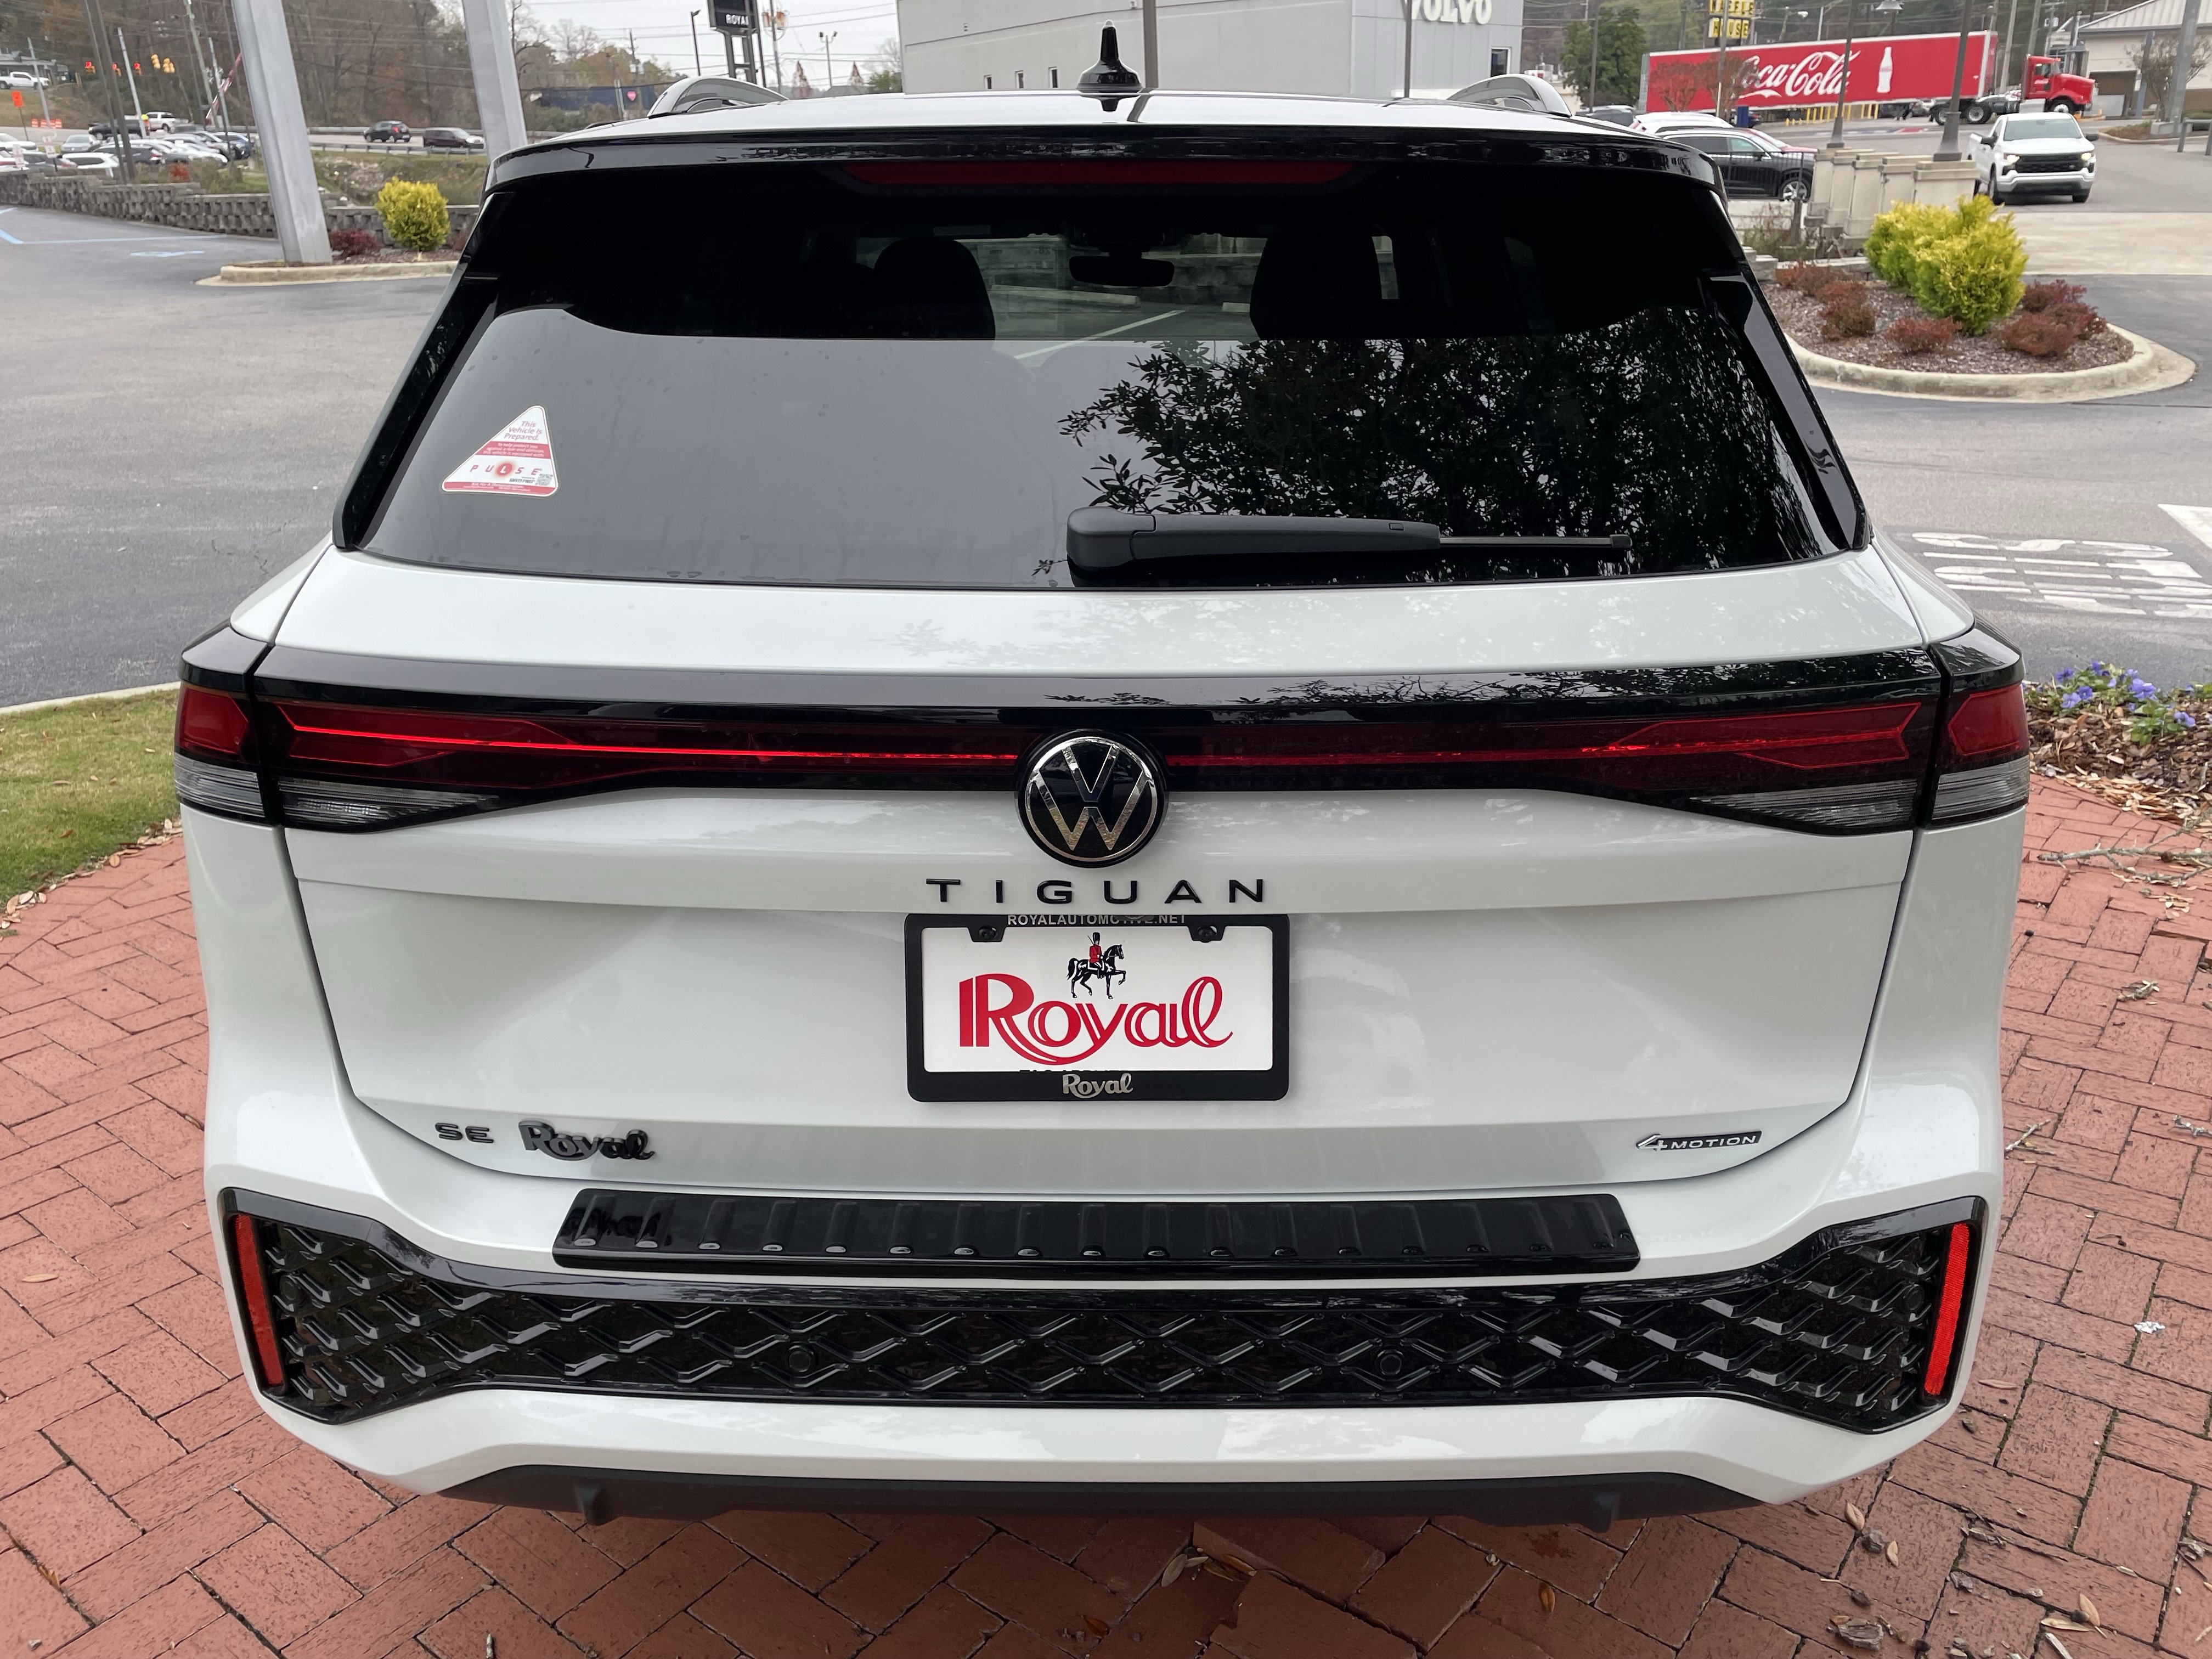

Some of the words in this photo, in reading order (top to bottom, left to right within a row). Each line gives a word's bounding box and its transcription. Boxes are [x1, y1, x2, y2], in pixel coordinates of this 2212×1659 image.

[1713, 21, 1748, 36] HUSE
[470, 465, 540, 475] PULSE
[926, 879, 1265, 905] TIGUAN
[1007, 914, 1186, 925] ROYALAUTOMO.NET
[959, 973, 1233, 1065] Royal
[1062, 1072, 1133, 1099] Royal
[435, 1122, 494, 1144] SE
[518, 1119, 655, 1161] Royal
[1636, 1133, 1757, 1152] 4MOTION
